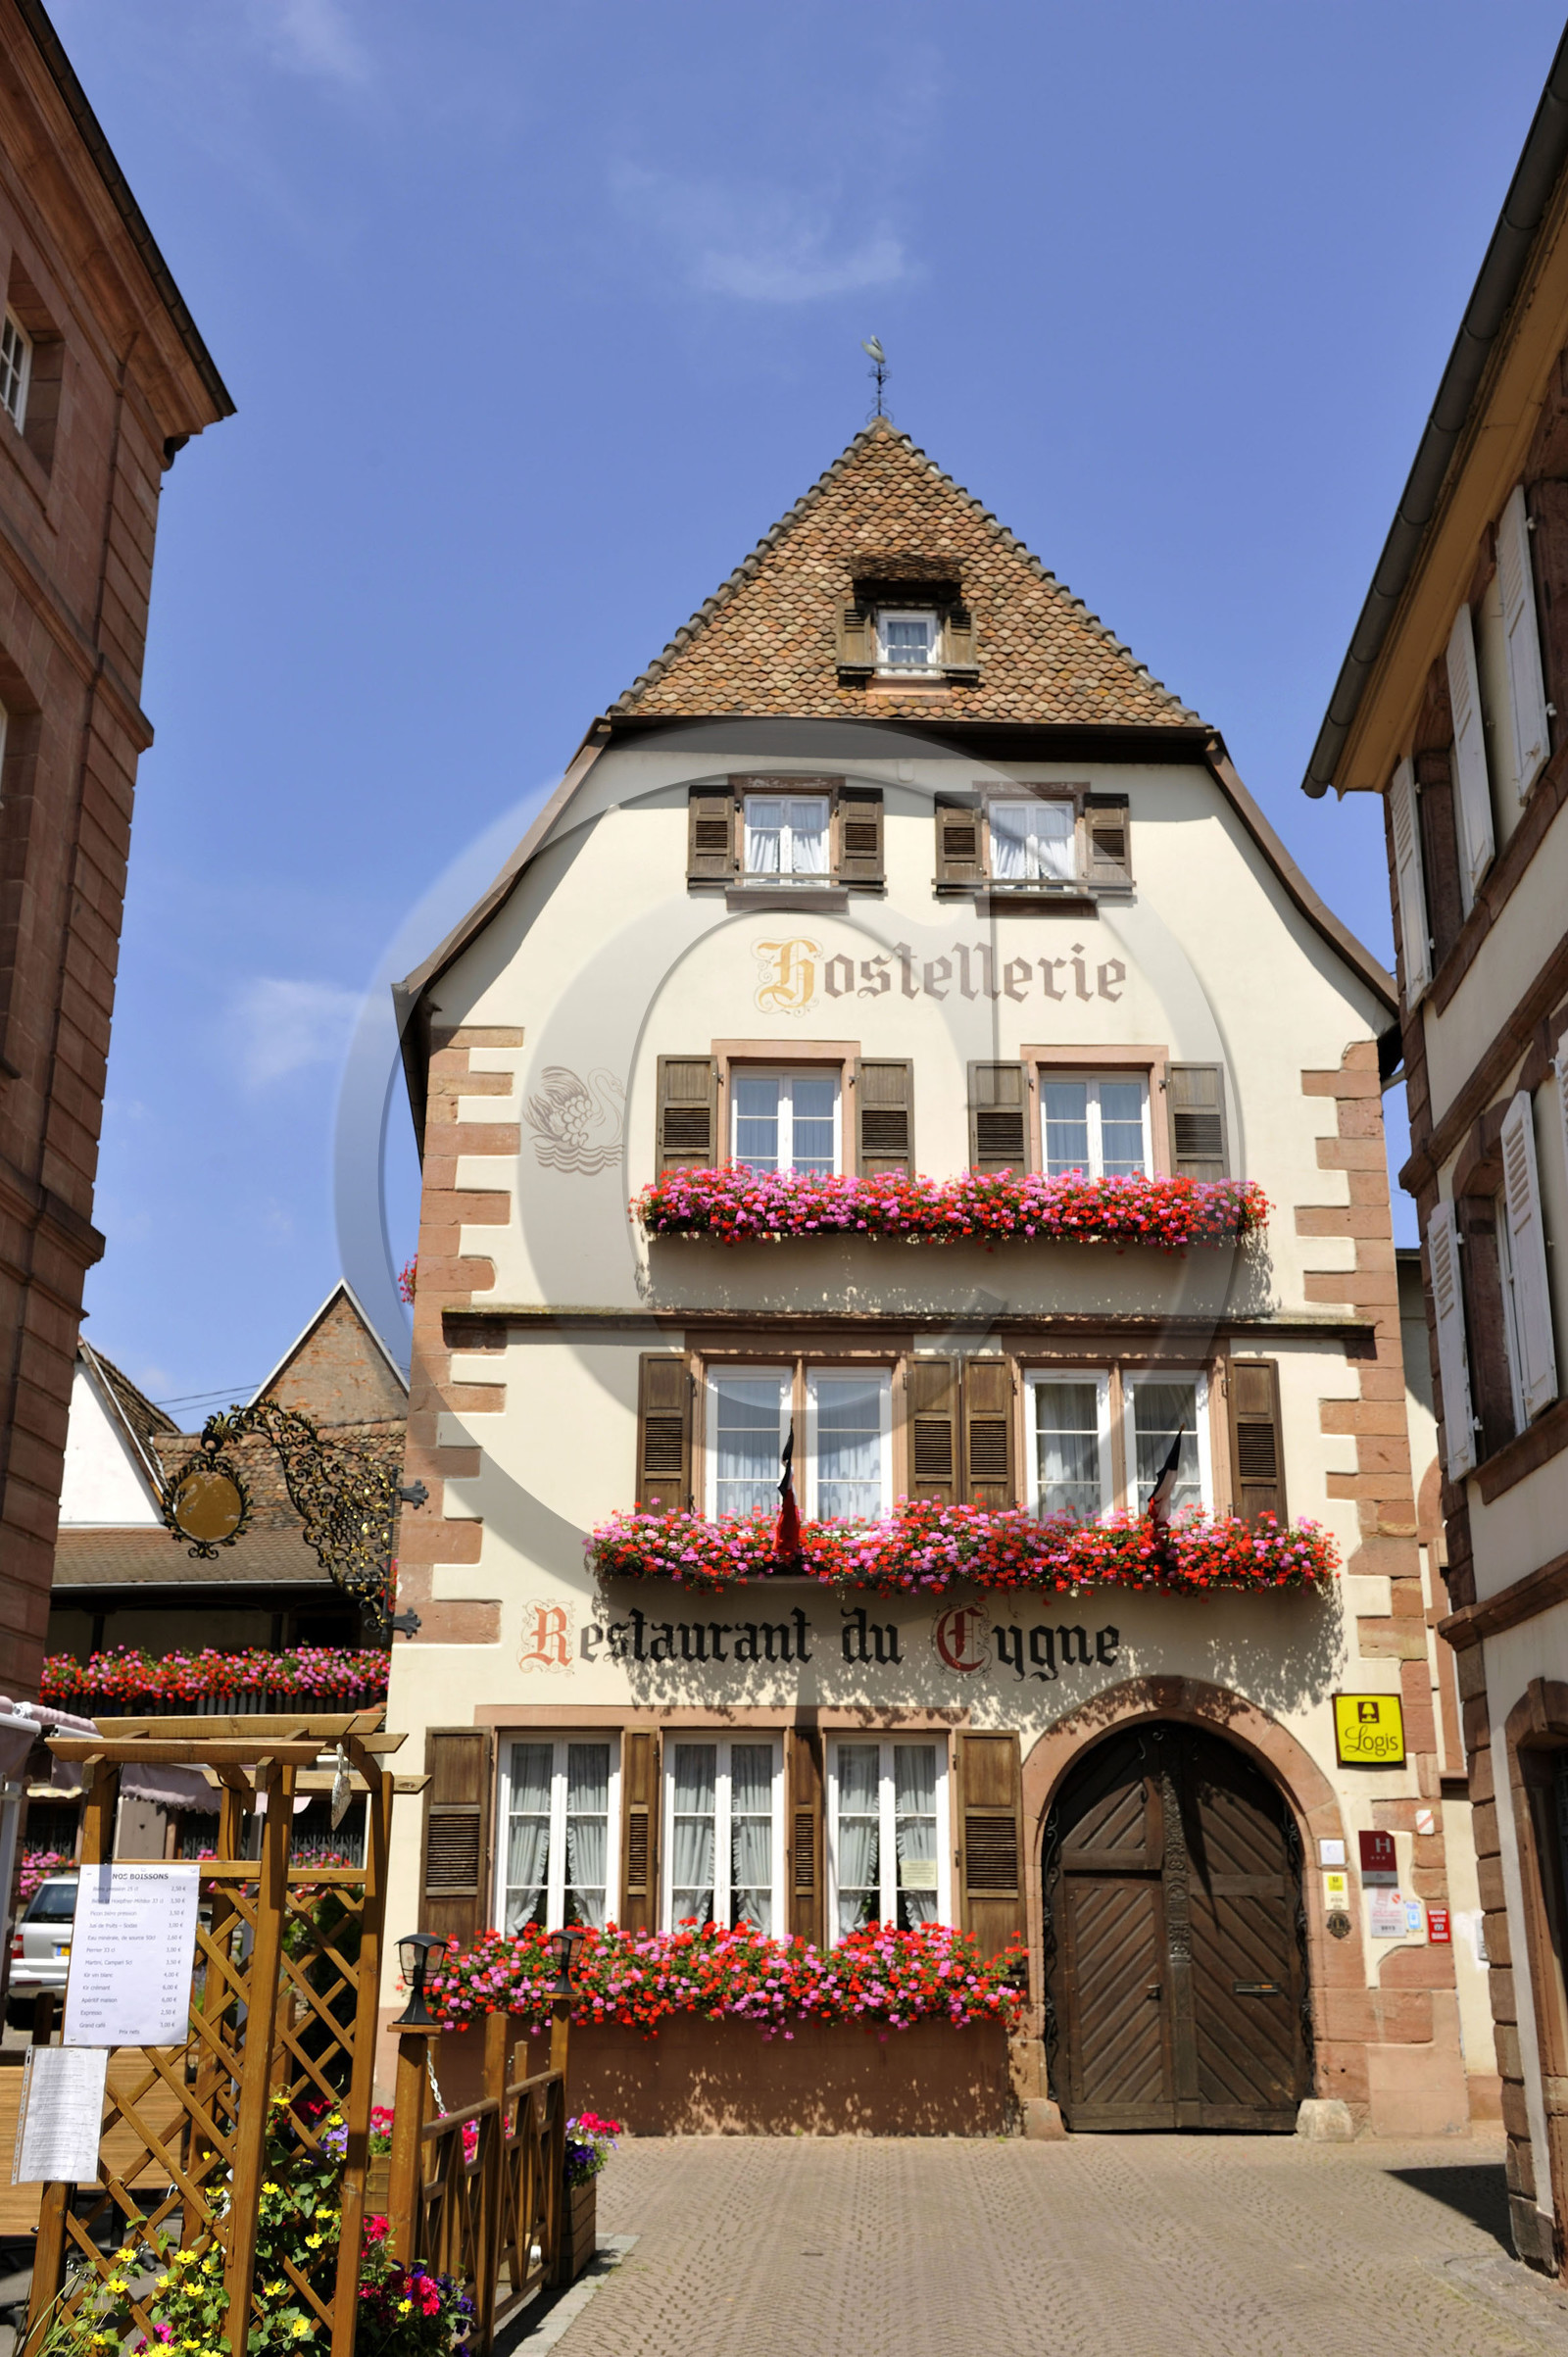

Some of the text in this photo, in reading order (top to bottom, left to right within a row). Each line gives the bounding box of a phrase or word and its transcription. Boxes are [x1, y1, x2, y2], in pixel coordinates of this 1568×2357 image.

[753, 937, 1126, 1012] Hostellerie
[518, 1604, 1119, 1682] Restaurant du Cygne
[1344, 1725, 1398, 1757] Logis
[1375, 1837, 1392, 1853] H
